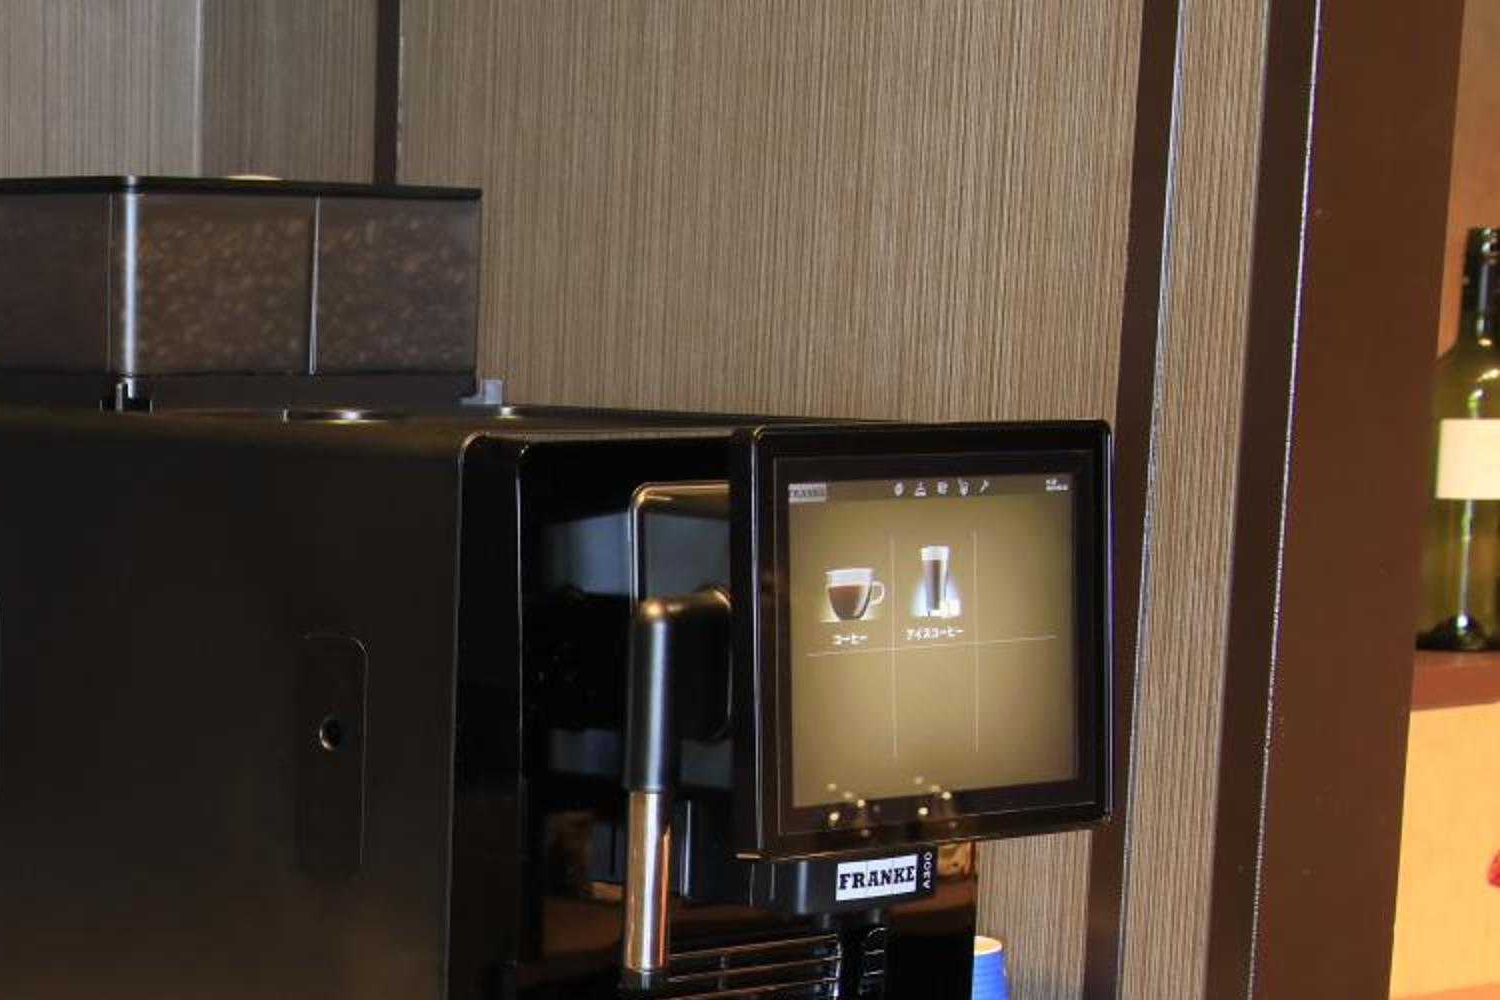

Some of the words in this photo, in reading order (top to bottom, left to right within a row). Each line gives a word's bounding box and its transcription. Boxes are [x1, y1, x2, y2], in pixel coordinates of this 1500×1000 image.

[833, 633, 868, 646] コーヒー
[906, 626, 965, 641] アイスコーヒー
[839, 866, 915, 891] FRANKE
